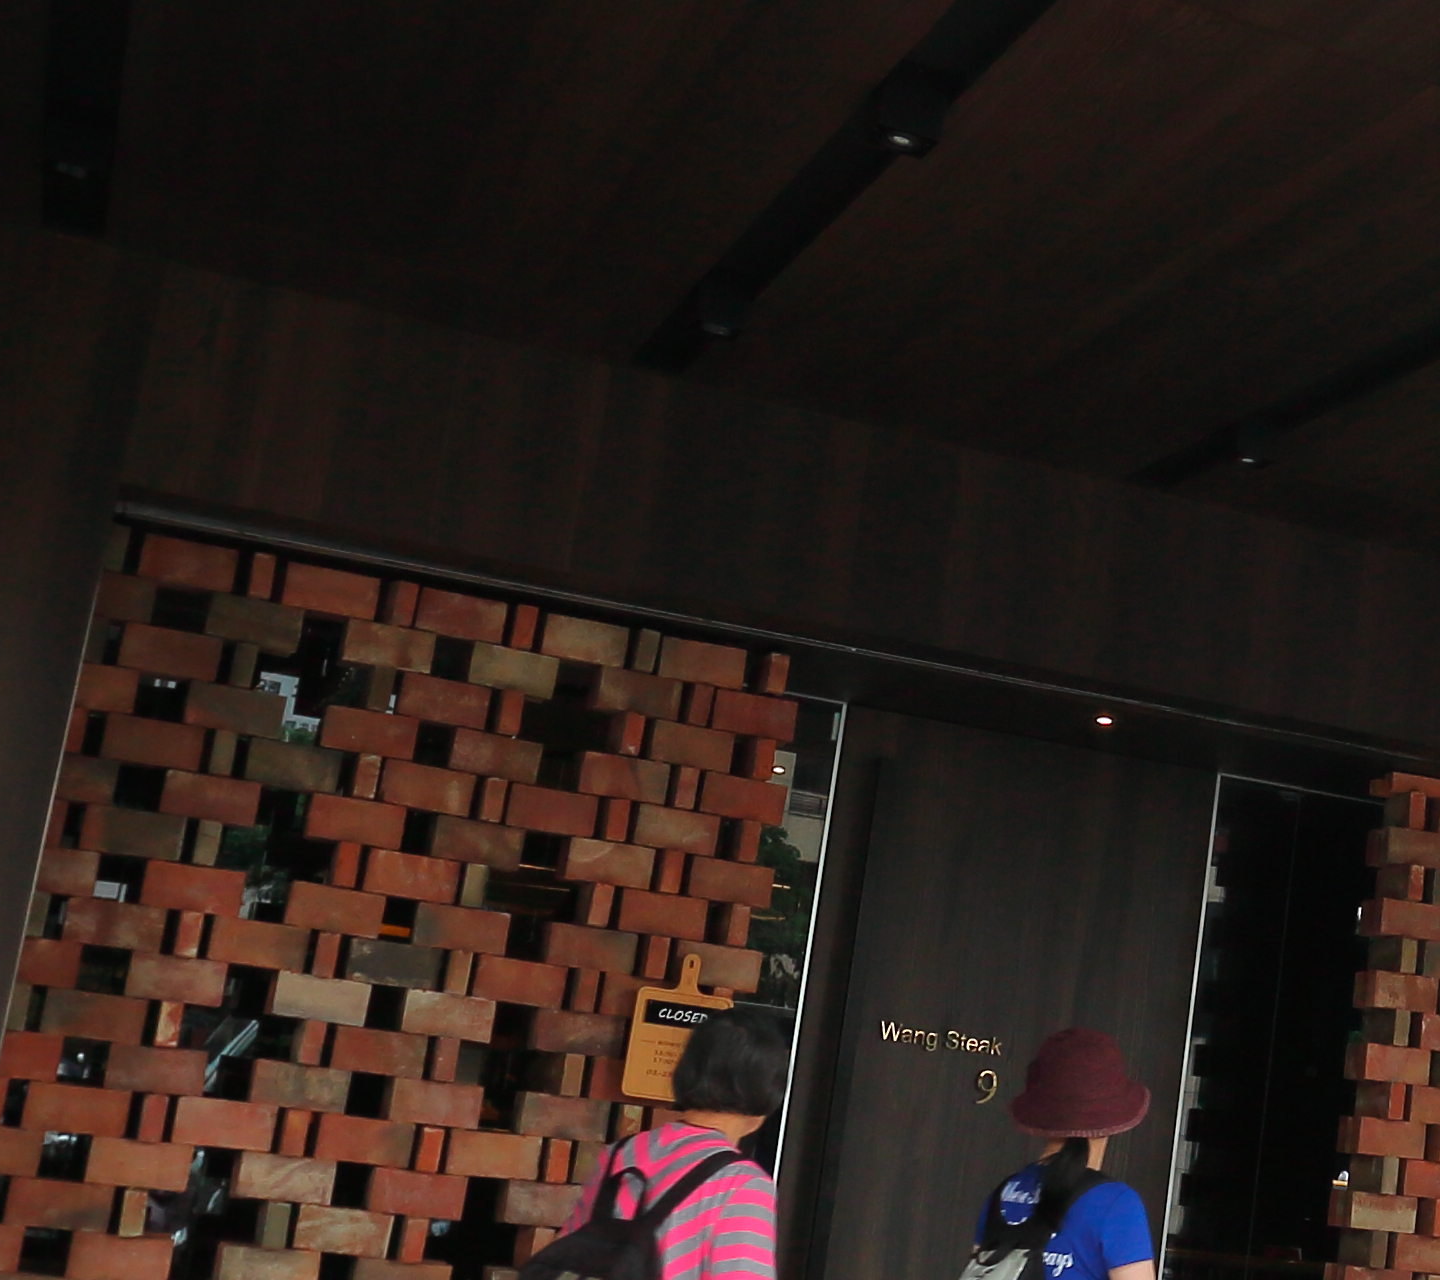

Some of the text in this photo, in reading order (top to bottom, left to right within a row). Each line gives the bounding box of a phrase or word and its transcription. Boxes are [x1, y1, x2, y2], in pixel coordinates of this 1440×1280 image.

[881, 1020, 1002, 1056] Wang Steak
[975, 1069, 998, 1105] 9
